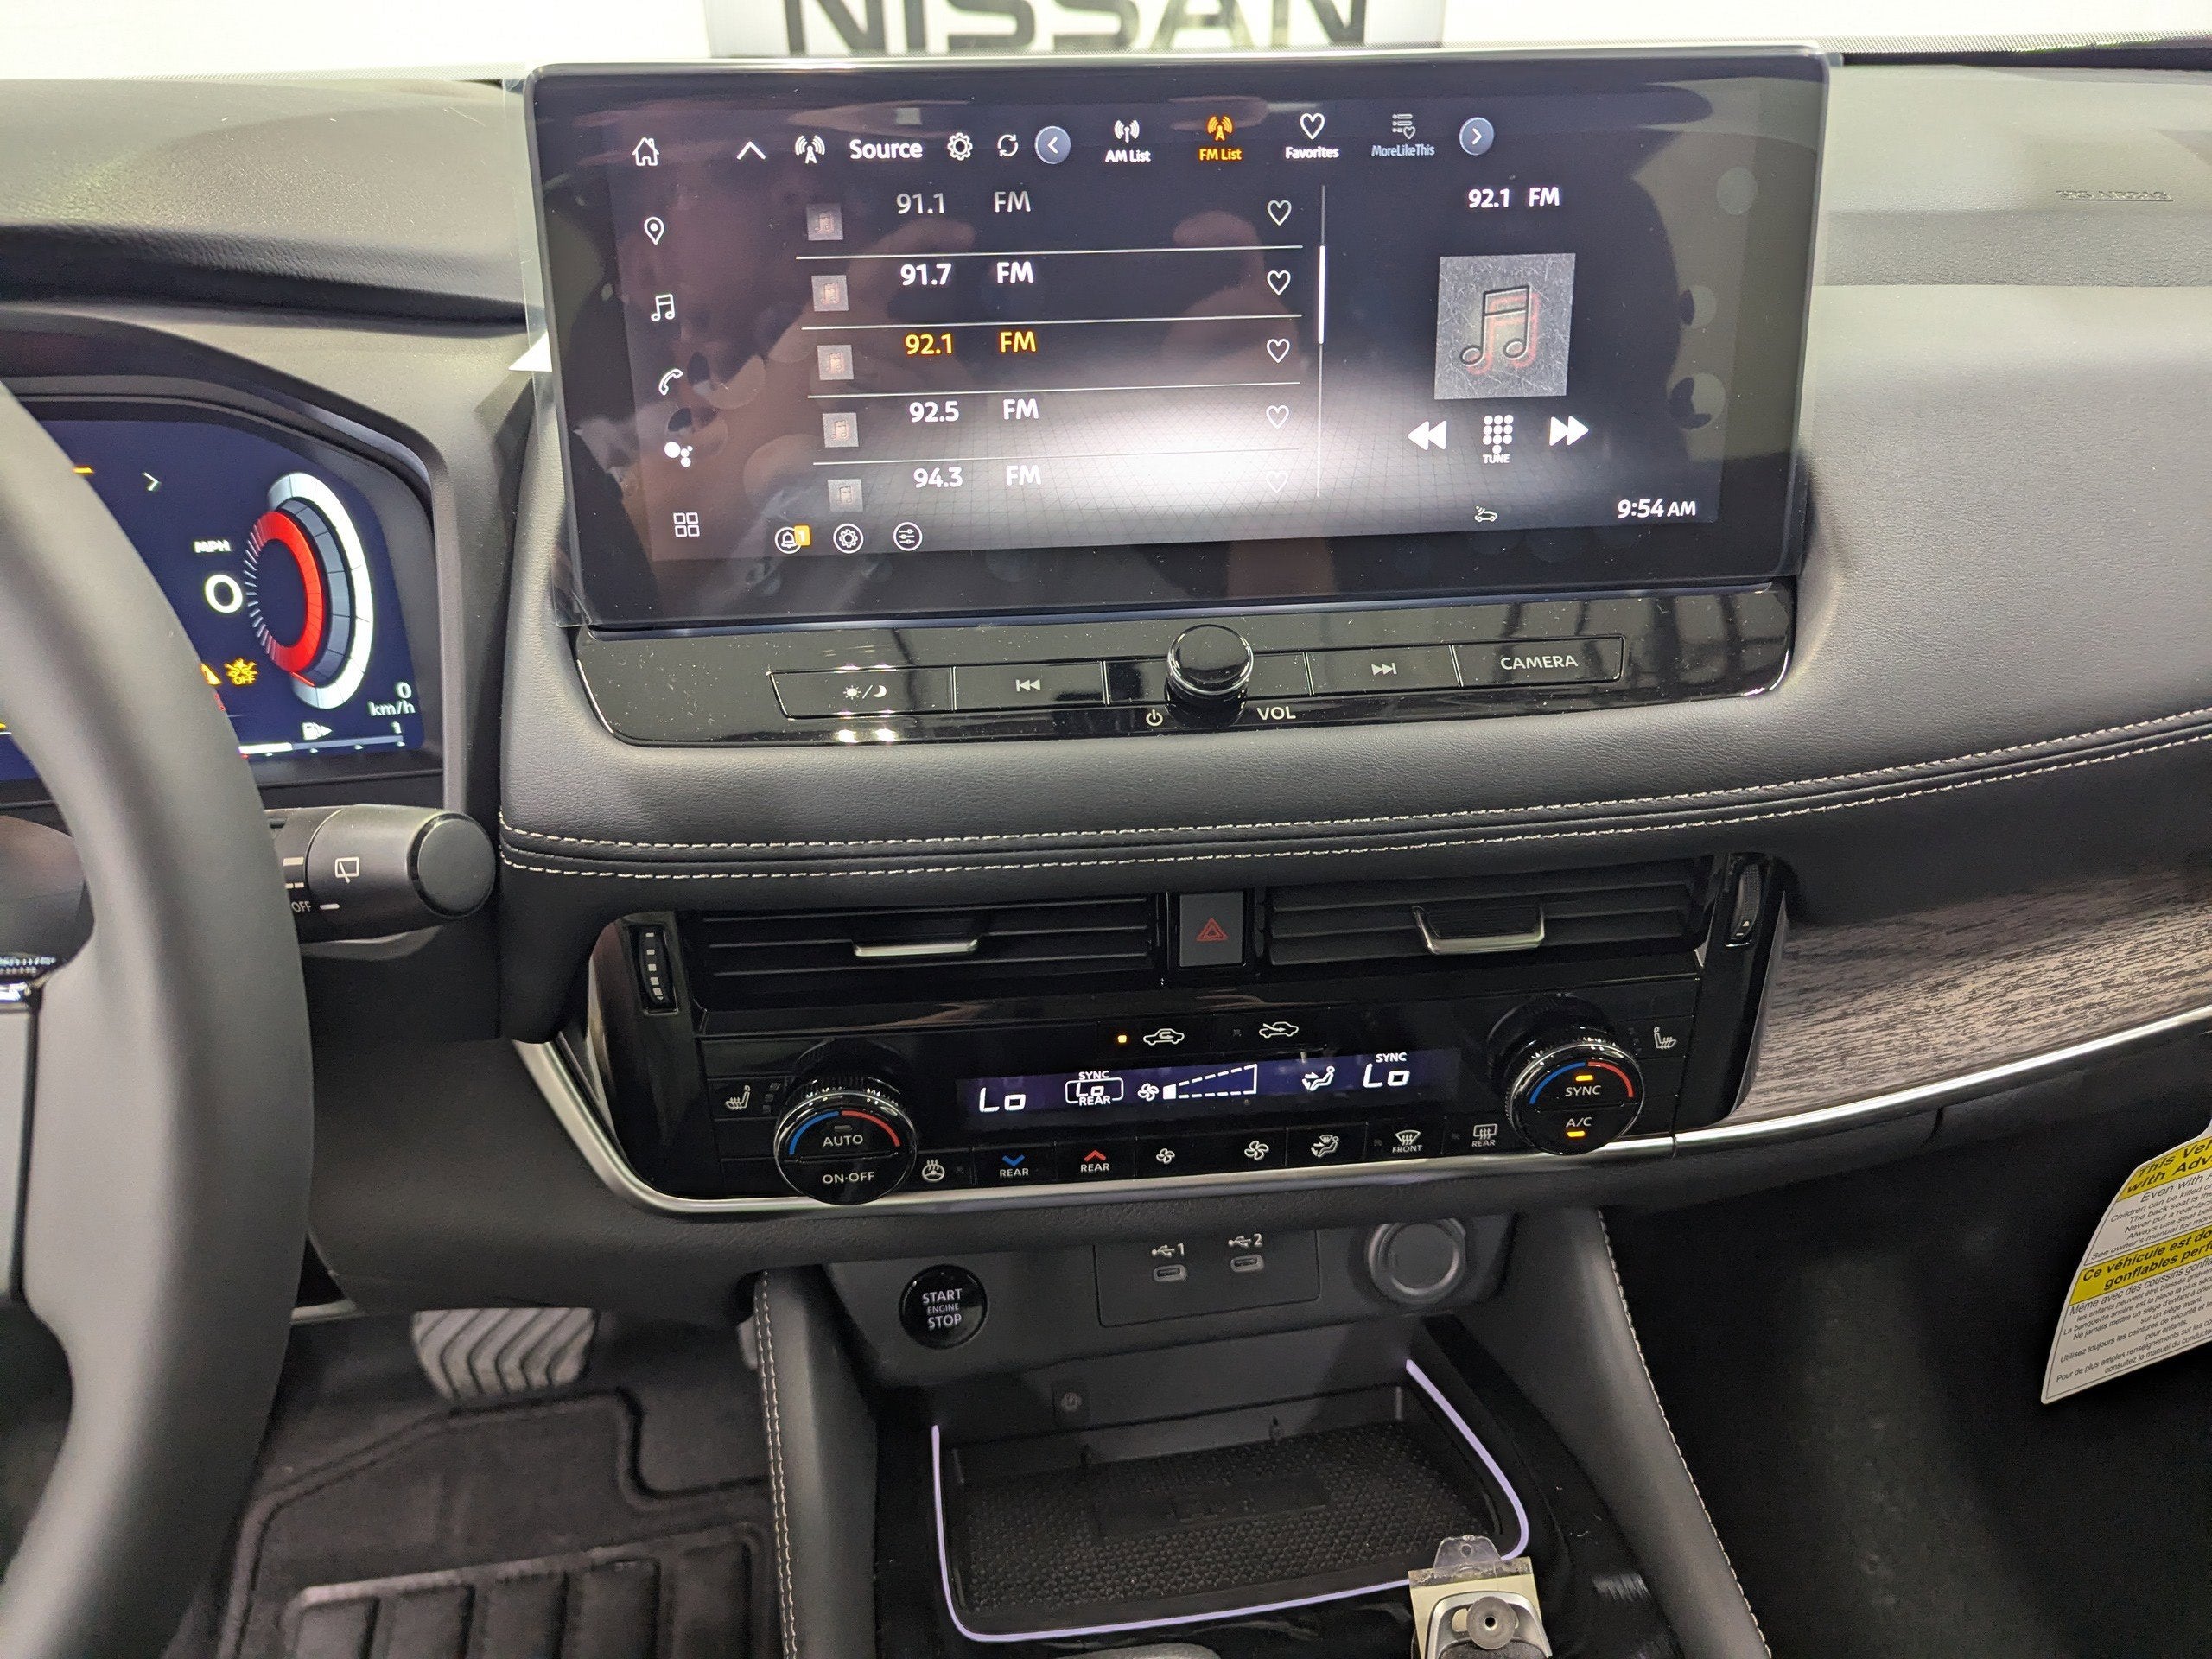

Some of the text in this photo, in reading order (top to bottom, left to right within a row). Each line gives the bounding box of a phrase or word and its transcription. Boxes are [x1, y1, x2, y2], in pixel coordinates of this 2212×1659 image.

[849, 138, 924, 160] Source
[1104, 149, 1152, 163] AM List
[1198, 148, 1243, 161] FM List
[1285, 145, 1340, 162] Favorites
[1370, 143, 1435, 157] MoreLikeThis
[896, 190, 1032, 214] 91.1 FM
[1468, 186, 1560, 209] 92.1 FM
[899, 261, 1034, 286] 91.7 FM
[905, 330, 1037, 355] 92.1 FM
[909, 398, 1039, 423] 92.5 FM
[1482, 454, 1510, 464] TUNE
[912, 464, 1042, 489] 94.3 FM
[1618, 498, 1696, 519] 9:54 AM
[798, 529, 806, 543] 1
[194, 539, 232, 554] MPH
[204, 574, 244, 613] 0
[1500, 654, 1579, 671] CAMERA
[396, 681, 412, 699] 0
[368, 699, 416, 716] km/h
[1255, 705, 1297, 721] VOL
[290, 900, 311, 912] OFF
[1374, 1051, 1408, 1064] SYNC
[1078, 1070, 1109, 1080] SYNC
[1565, 1084, 1602, 1097] SYNC
[1078, 1095, 1111, 1106] REAR
[1565, 1116, 1592, 1128] A/C
[823, 1134, 864, 1147] AUTO
[1471, 1138, 1496, 1147] REAR
[1391, 1144, 1423, 1154] FRONT
[999, 1167, 1029, 1178] REAR
[1079, 1163, 1110, 1173] REAR
[2139, 1156, 2176, 1178] This
[2127, 1172, 2166, 1193] with
[2140, 1185, 2174, 1202] Even
[2178, 1174, 2203, 1190] with
[1253, 1233, 1263, 1247] 2
[1177, 1243, 1185, 1255] 1
[2083, 1268, 2102, 1281] Ce
[2107, 1246, 2165, 1274] véhicule
[2170, 1236, 2193, 1251] est
[2104, 1255, 2178, 1291] gonflables
[2101, 1290, 2124, 1305] avec
[2126, 1284, 2143, 1295] des
[2144, 1268, 2183, 1288] coussins
[922, 1288, 963, 1305] START
[926, 1302, 961, 1314] ENGINE
[927, 1313, 963, 1329] STOP
